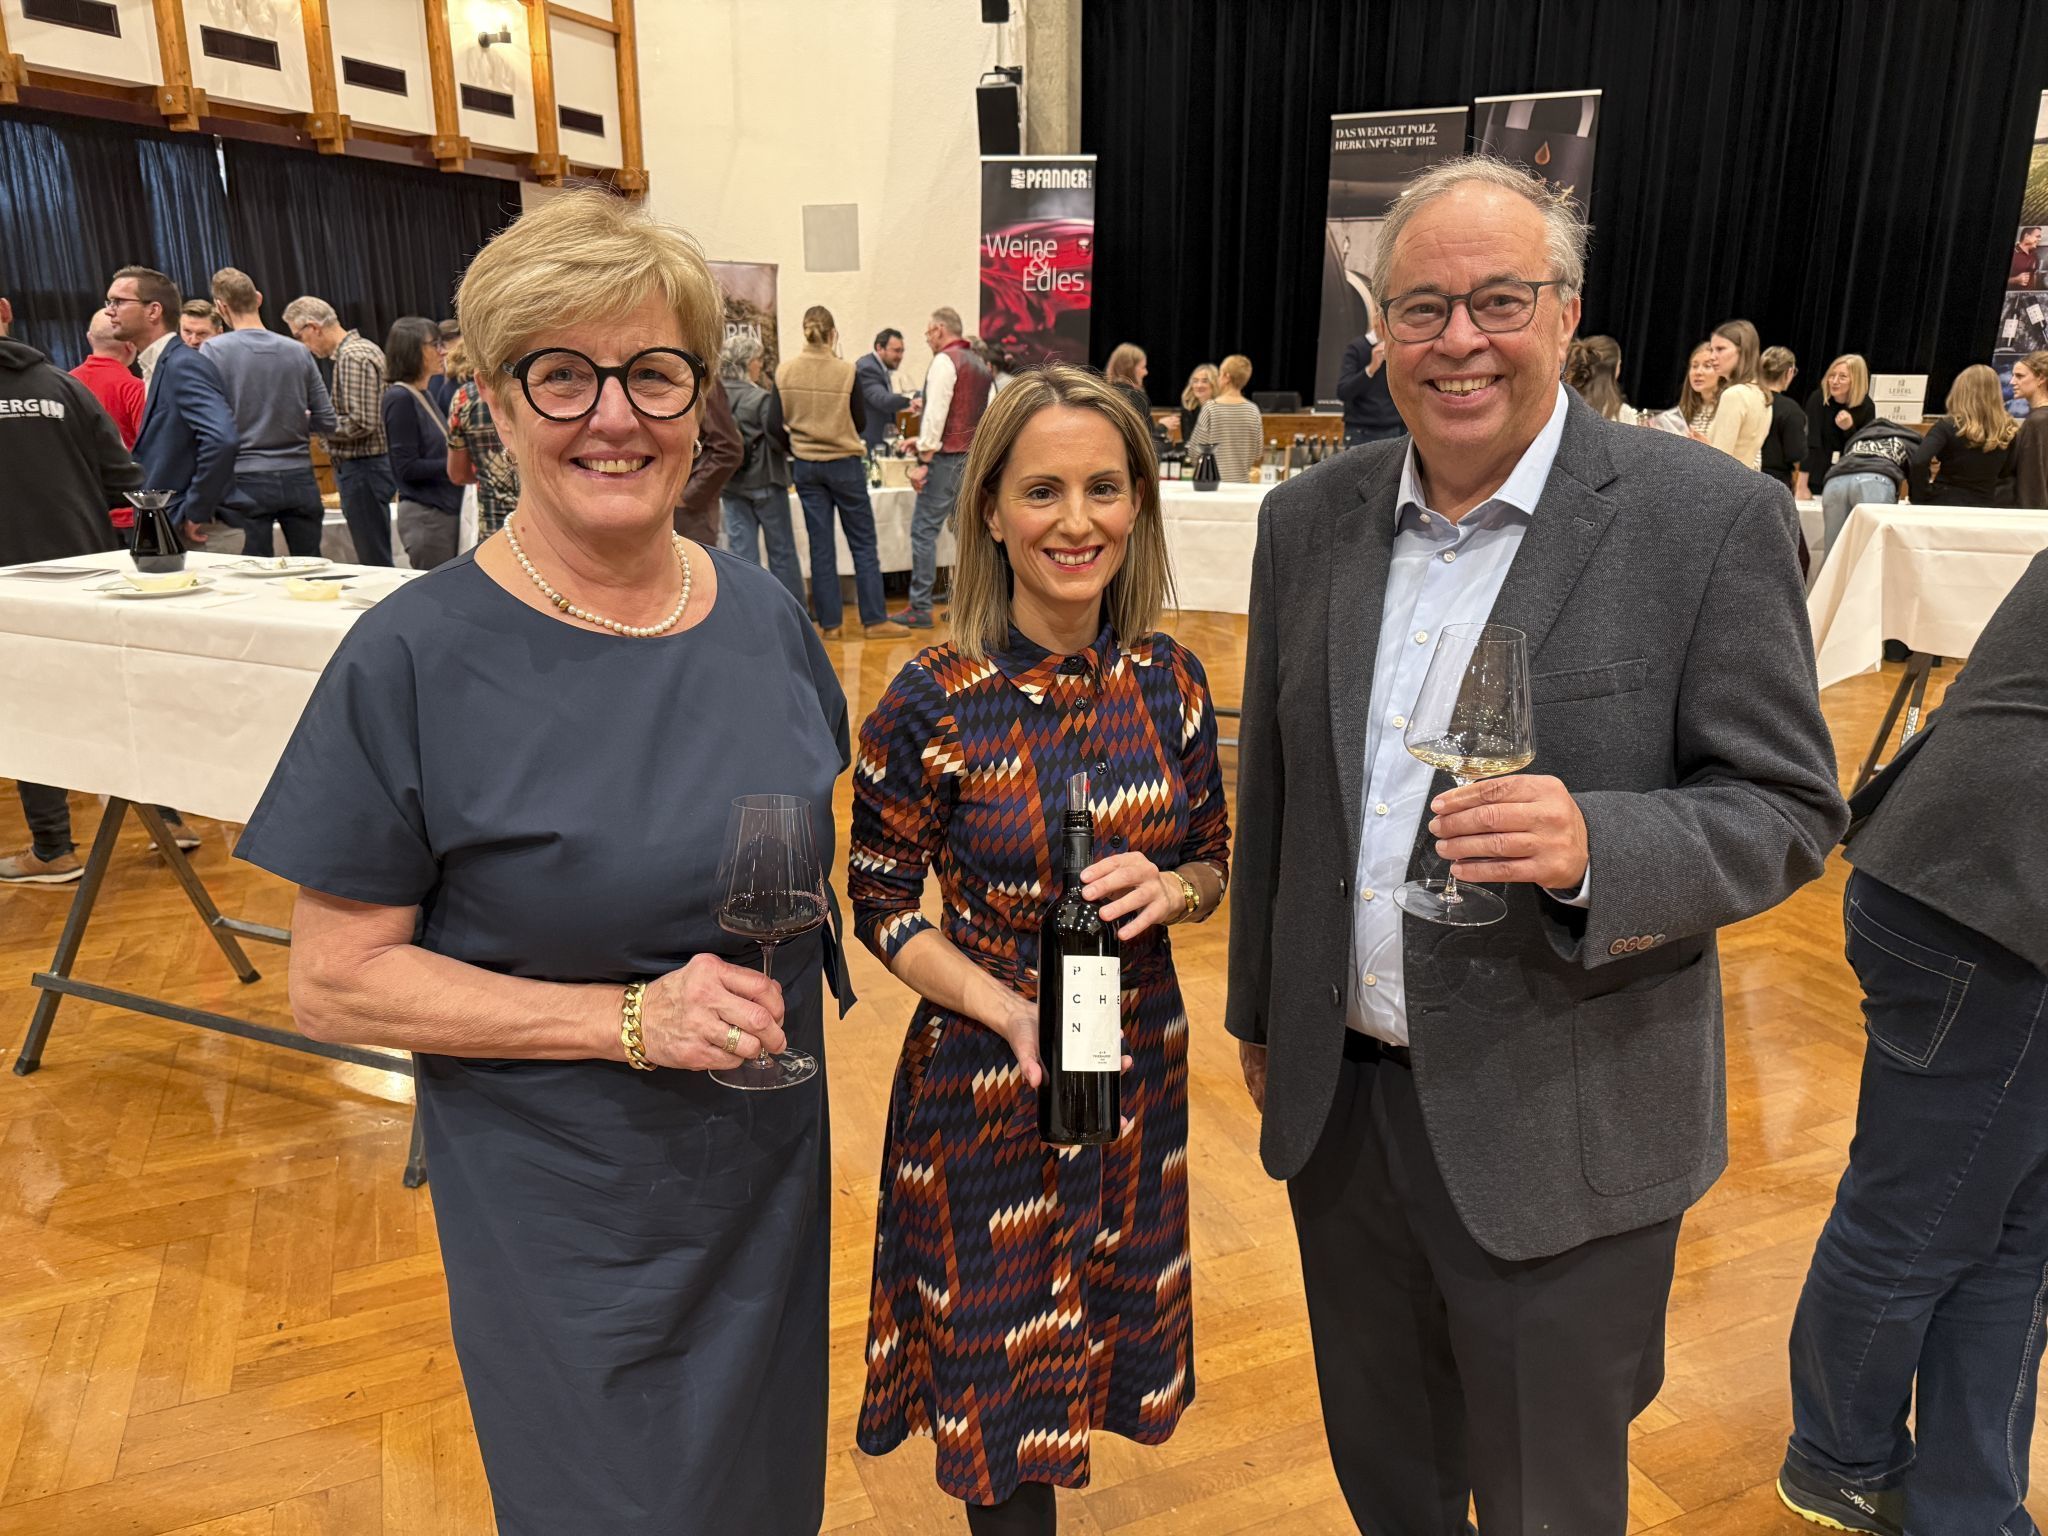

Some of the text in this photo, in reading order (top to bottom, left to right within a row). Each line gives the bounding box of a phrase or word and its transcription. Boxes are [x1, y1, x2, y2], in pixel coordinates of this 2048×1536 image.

[1336, 128, 1356, 139] DAS
[1357, 124, 1407, 137] WEINGUT
[1335, 138, 1389, 151] HERKUNFT
[1390, 137, 1414, 148] SEIT
[1026, 168, 1088, 189] PFANNER
[985, 233, 1058, 258] Weine
[1029, 249, 1050, 276] &
[1022, 266, 1085, 292] Edles
